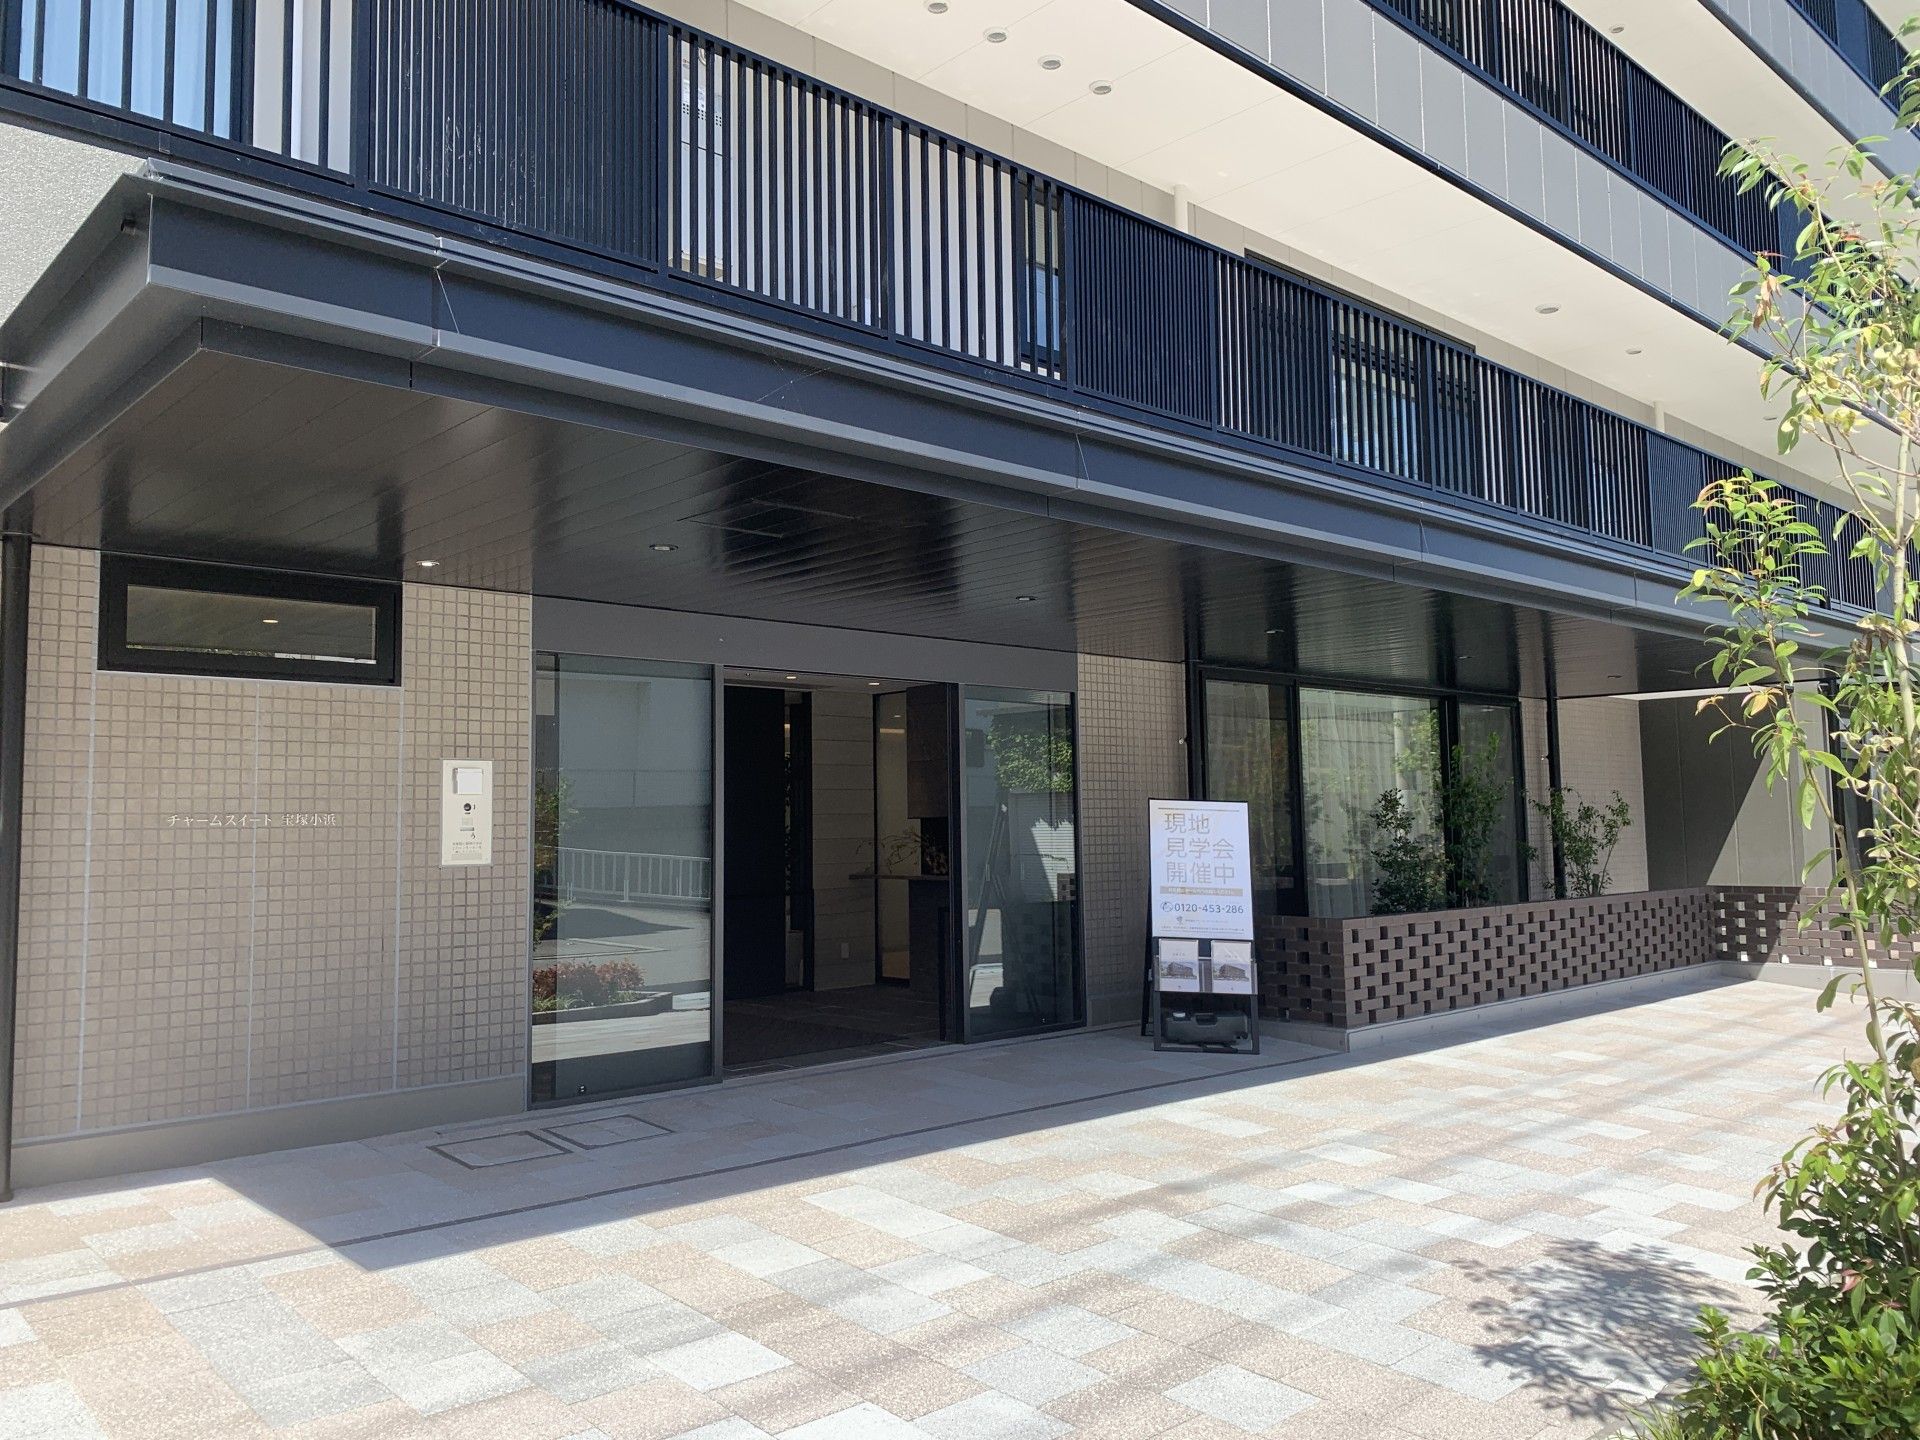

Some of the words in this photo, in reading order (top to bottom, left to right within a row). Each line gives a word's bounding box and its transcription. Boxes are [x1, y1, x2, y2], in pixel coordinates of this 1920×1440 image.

[167, 813, 272, 827] チャームスイート
[281, 813, 336, 827] 宝塚小浜
[1164, 812, 1210, 835] 現地
[1165, 837, 1234, 859] 見学会
[1166, 861, 1235, 885] 開催中
